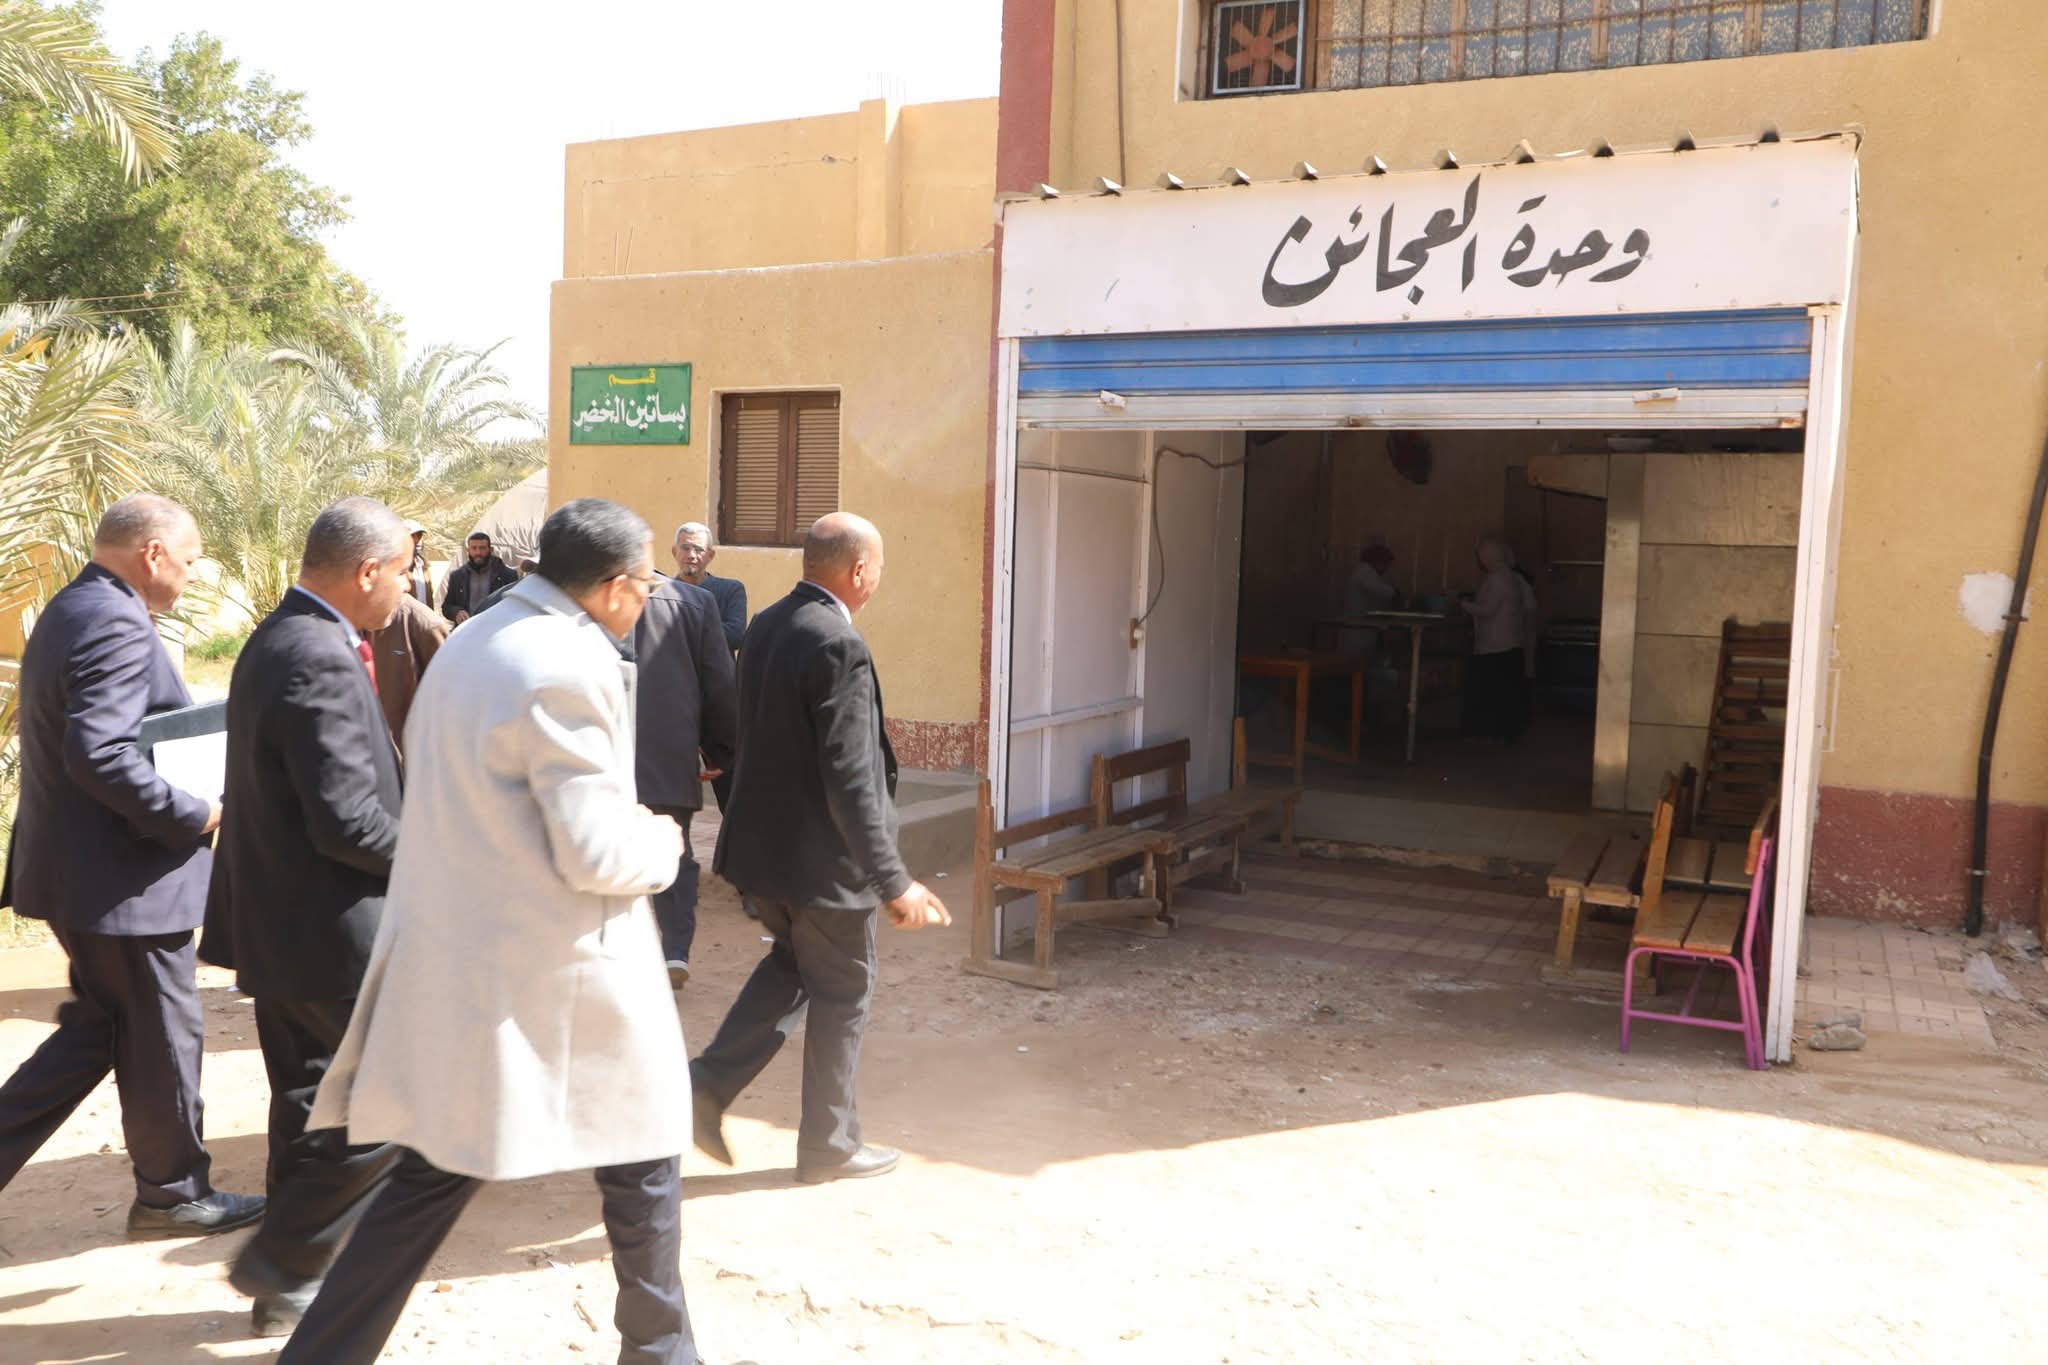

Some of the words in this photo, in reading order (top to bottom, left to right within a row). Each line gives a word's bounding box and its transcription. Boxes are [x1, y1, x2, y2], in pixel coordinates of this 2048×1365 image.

[1261, 173, 1481, 308] العجائن
[1501, 194, 1651, 288] وحدة
[608, 367, 656, 386] قسم
[626, 391, 687, 430] بساتين
